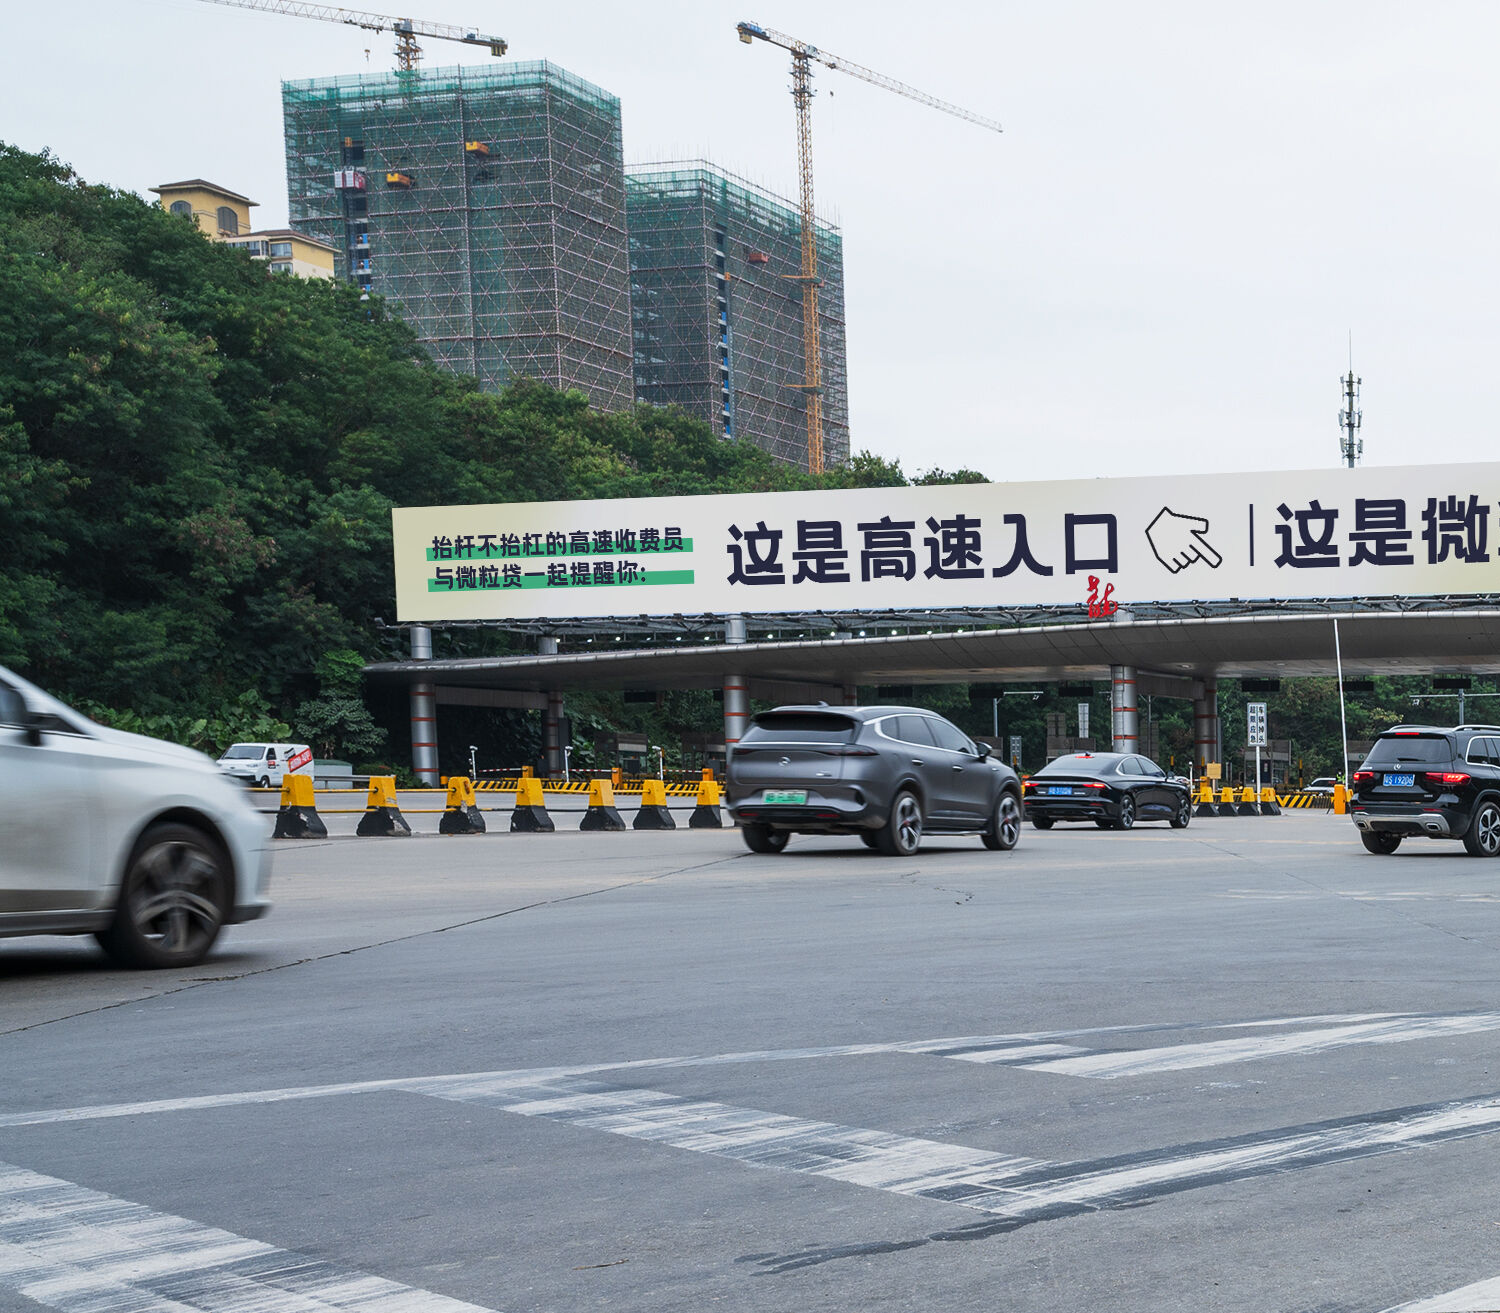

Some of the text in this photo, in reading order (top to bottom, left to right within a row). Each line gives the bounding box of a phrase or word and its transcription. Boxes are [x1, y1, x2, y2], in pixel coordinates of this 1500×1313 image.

[431, 527, 684, 559] 抬杆不抬杠的高速收费员
[726, 513, 1118, 587] 这是高速入口
